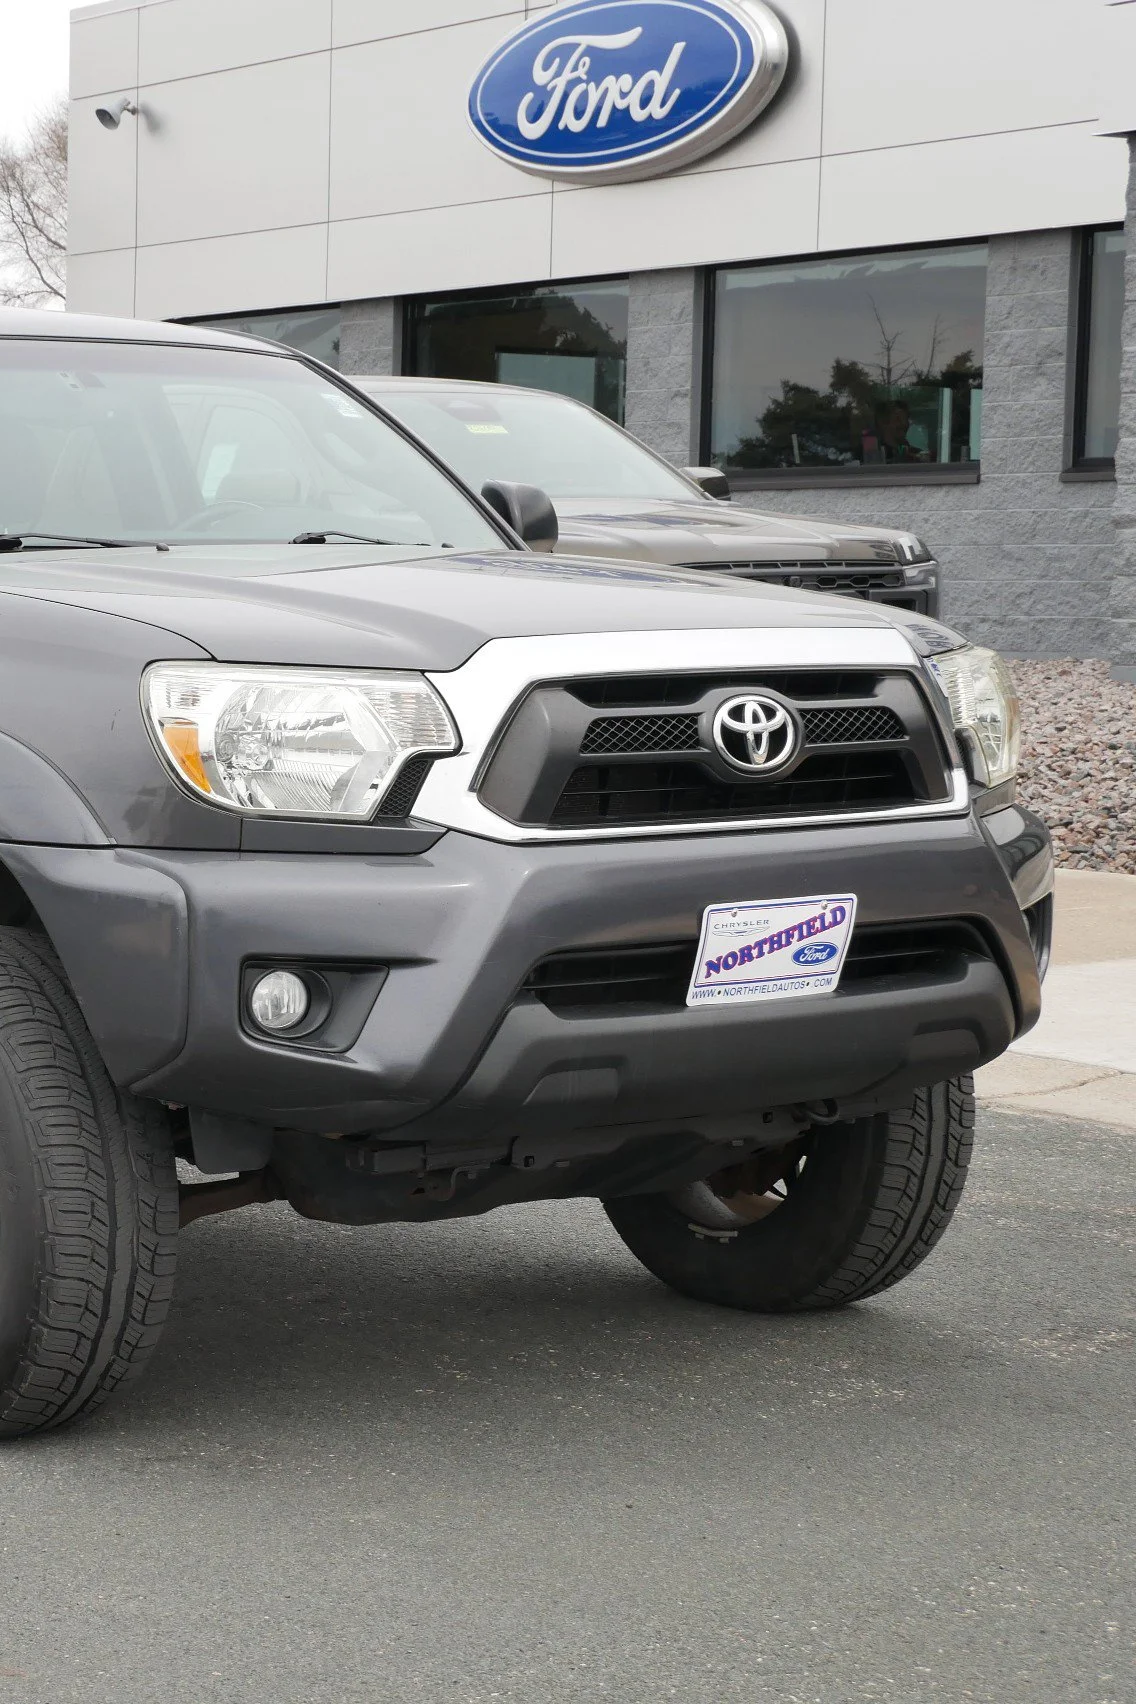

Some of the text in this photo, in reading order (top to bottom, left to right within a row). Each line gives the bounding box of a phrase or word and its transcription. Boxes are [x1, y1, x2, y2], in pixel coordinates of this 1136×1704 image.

[517, 26, 686, 140] Ford
[704, 905, 846, 979] NORTHFIELD
[713, 919, 770, 930] CHRYSLER
[799, 945, 830, 962] Ford
